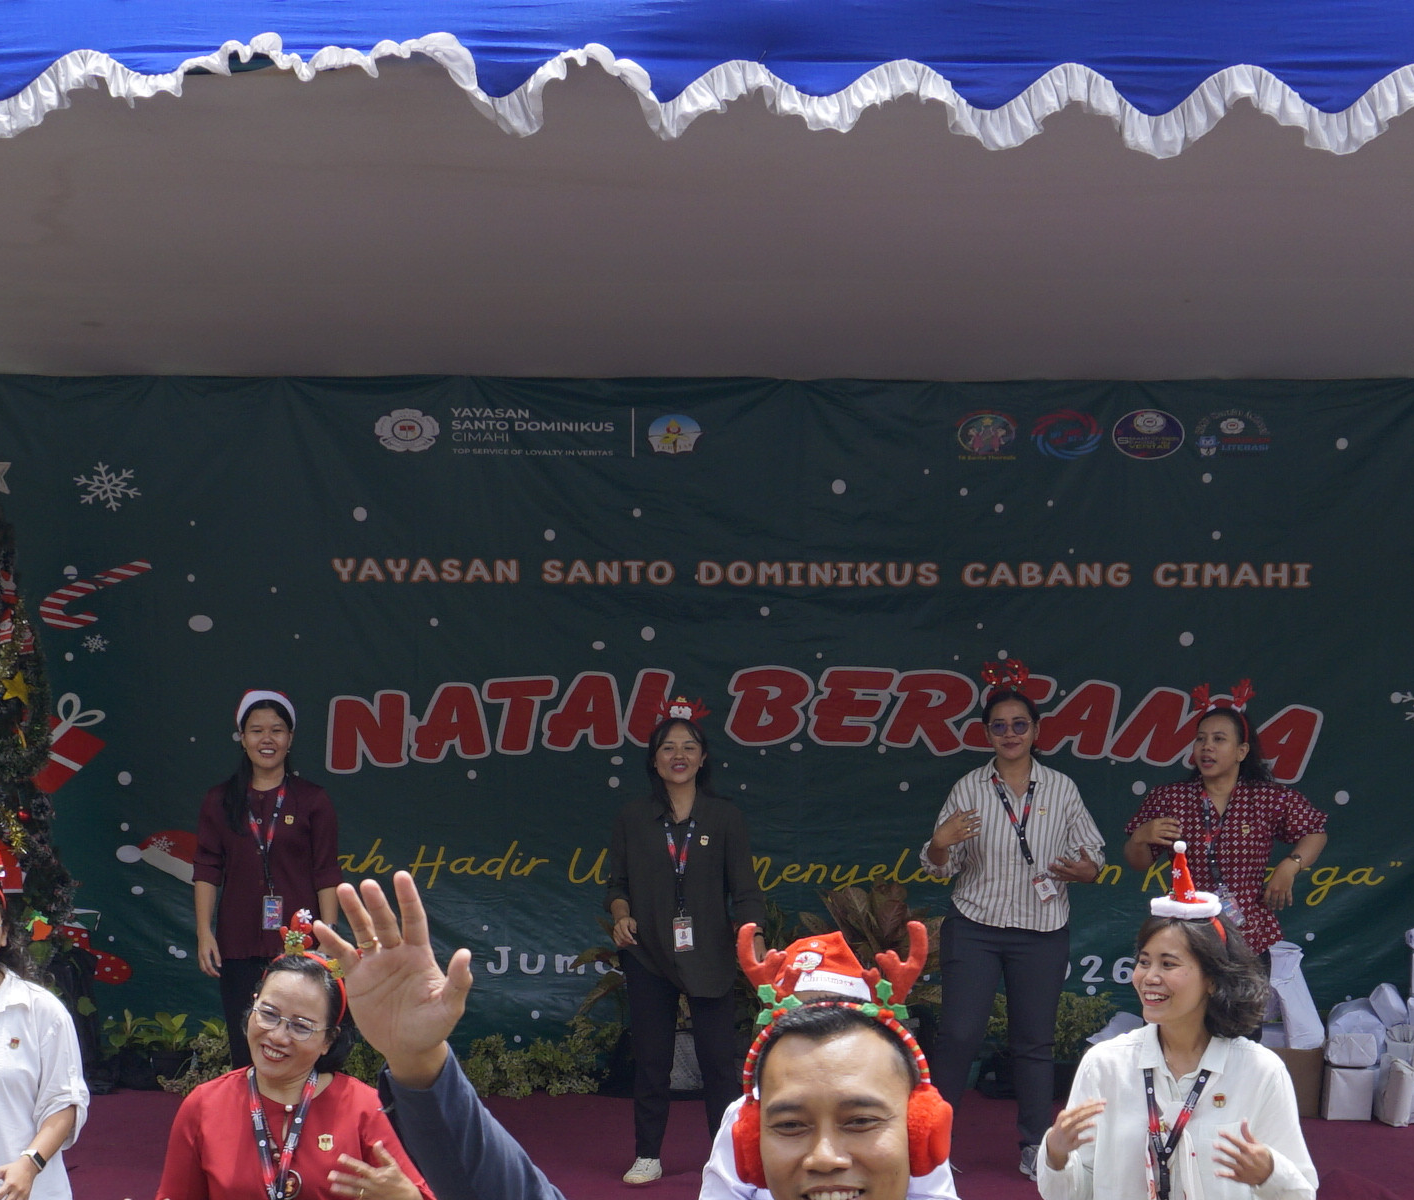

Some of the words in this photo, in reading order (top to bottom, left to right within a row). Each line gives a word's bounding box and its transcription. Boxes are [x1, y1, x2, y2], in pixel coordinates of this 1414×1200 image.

[451, 407, 529, 419] YAYASAN
[452, 420, 509, 431] SANTO
[514, 421, 615, 432] DOMINIKUS
[452, 432, 509, 443] CIMAHI
[472, 448, 510, 456] SERVICE
[525, 449, 563, 457] LOYALTY
[331, 557, 520, 584] YAYASAN
[541, 559, 675, 586] SANTO
[697, 560, 939, 587] DOMINIKUS
[961, 562, 1131, 587] CABANG
[1153, 562, 1312, 588] CIMAHI
[325, 668, 675, 774] NATAL
[408, 840, 549, 890] Hadir
[1064, 955, 1136, 984] 26
